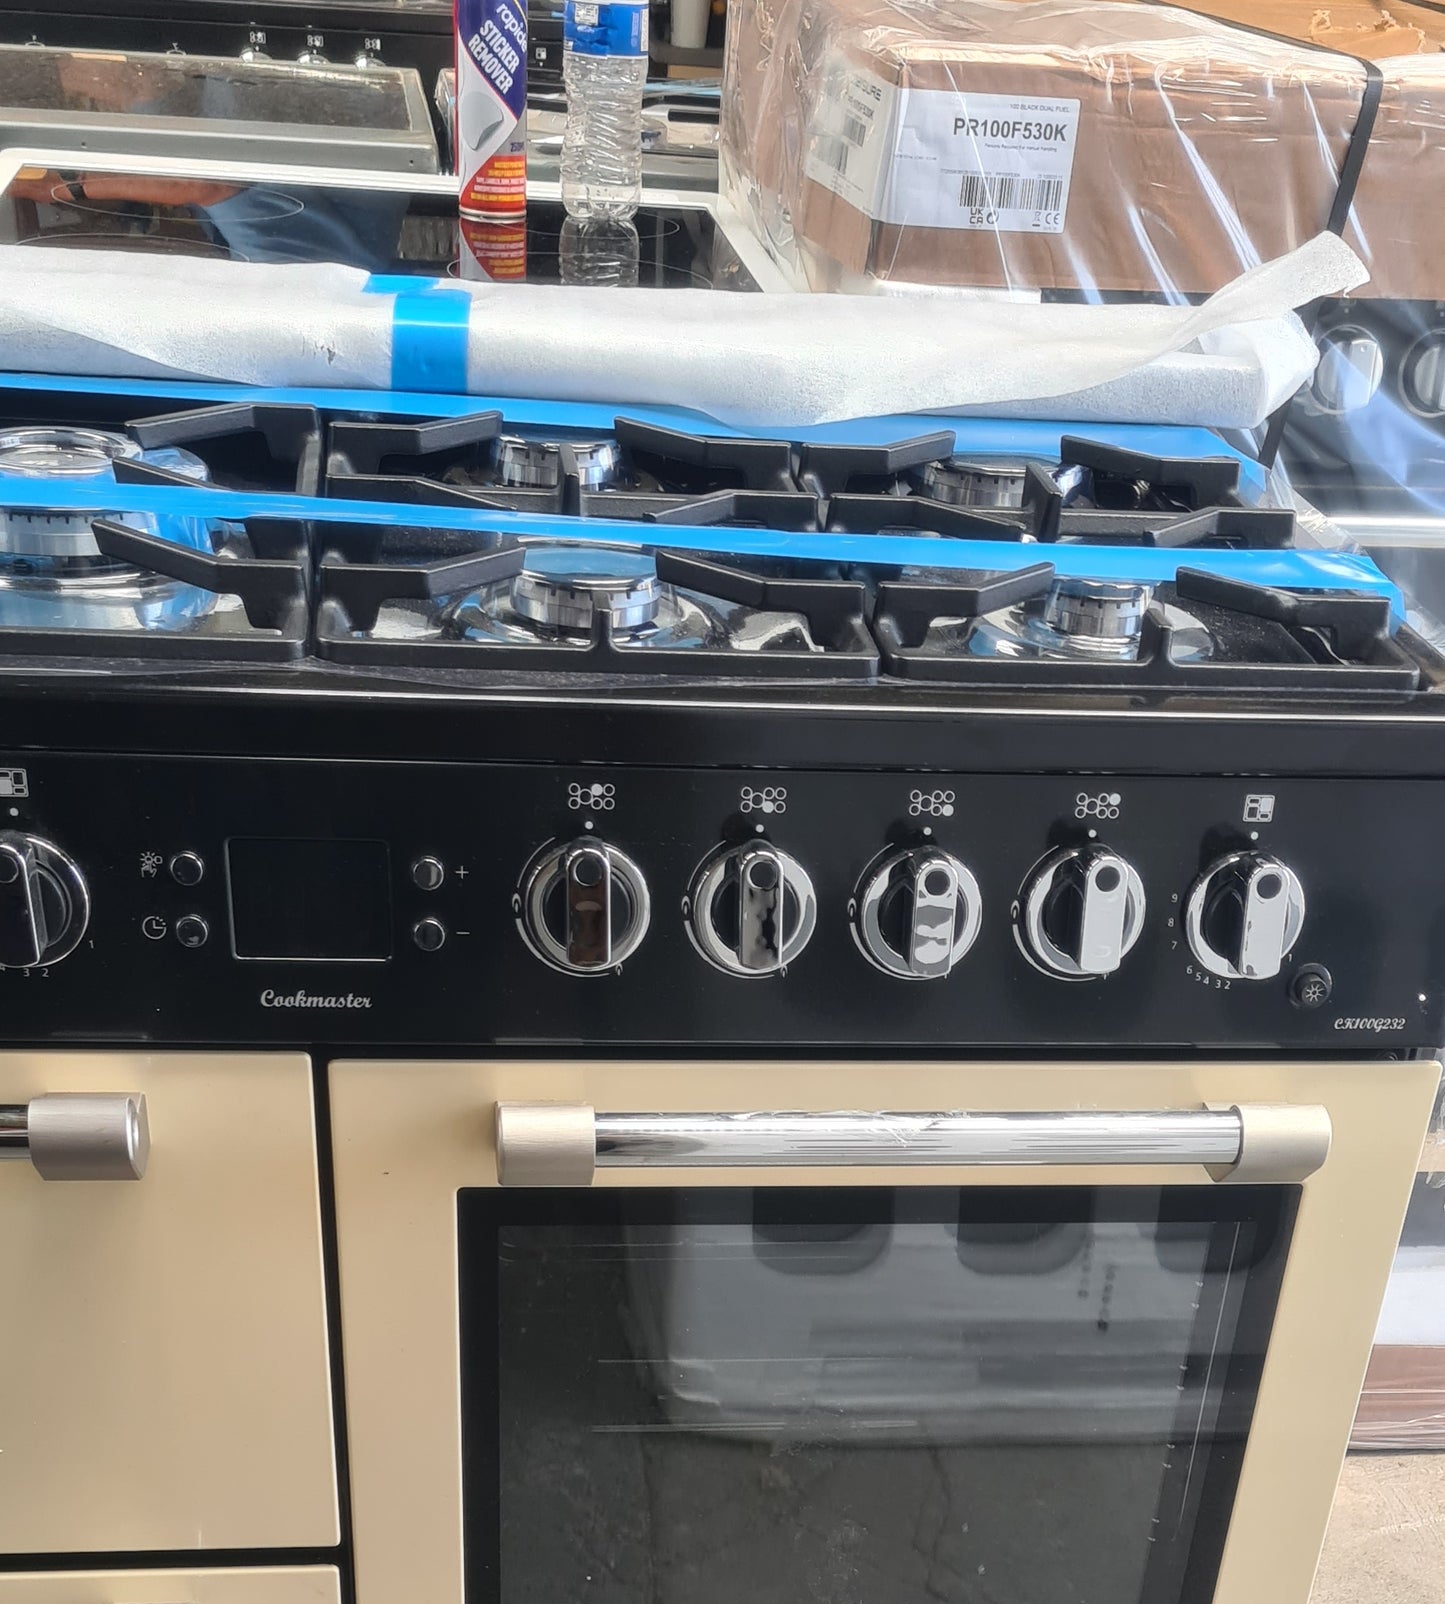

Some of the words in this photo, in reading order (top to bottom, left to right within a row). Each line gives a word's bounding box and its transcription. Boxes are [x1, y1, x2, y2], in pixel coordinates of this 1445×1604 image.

[480, 20, 520, 74] STICKER
[468, 34, 513, 95] REMOVER
[1020, 103, 1039, 111] BLACK
[953, 117, 1068, 142] PR100F530K
[1171, 893, 1178, 903] 9
[1167, 917, 1175, 928] 8
[1171, 940, 1178, 950] 7
[23, 967, 31, 977] 3
[41, 967, 50, 978] 2
[1186, 965, 1193, 975] 6
[1195, 972, 1202, 981] 5
[1202, 976, 1210, 985] 4
[1215, 979, 1222, 989] 3
[1224, 980, 1231, 990] 2
[260, 988, 373, 1008] Cookmaster
[1334, 1017, 1406, 1033] CK100G232
